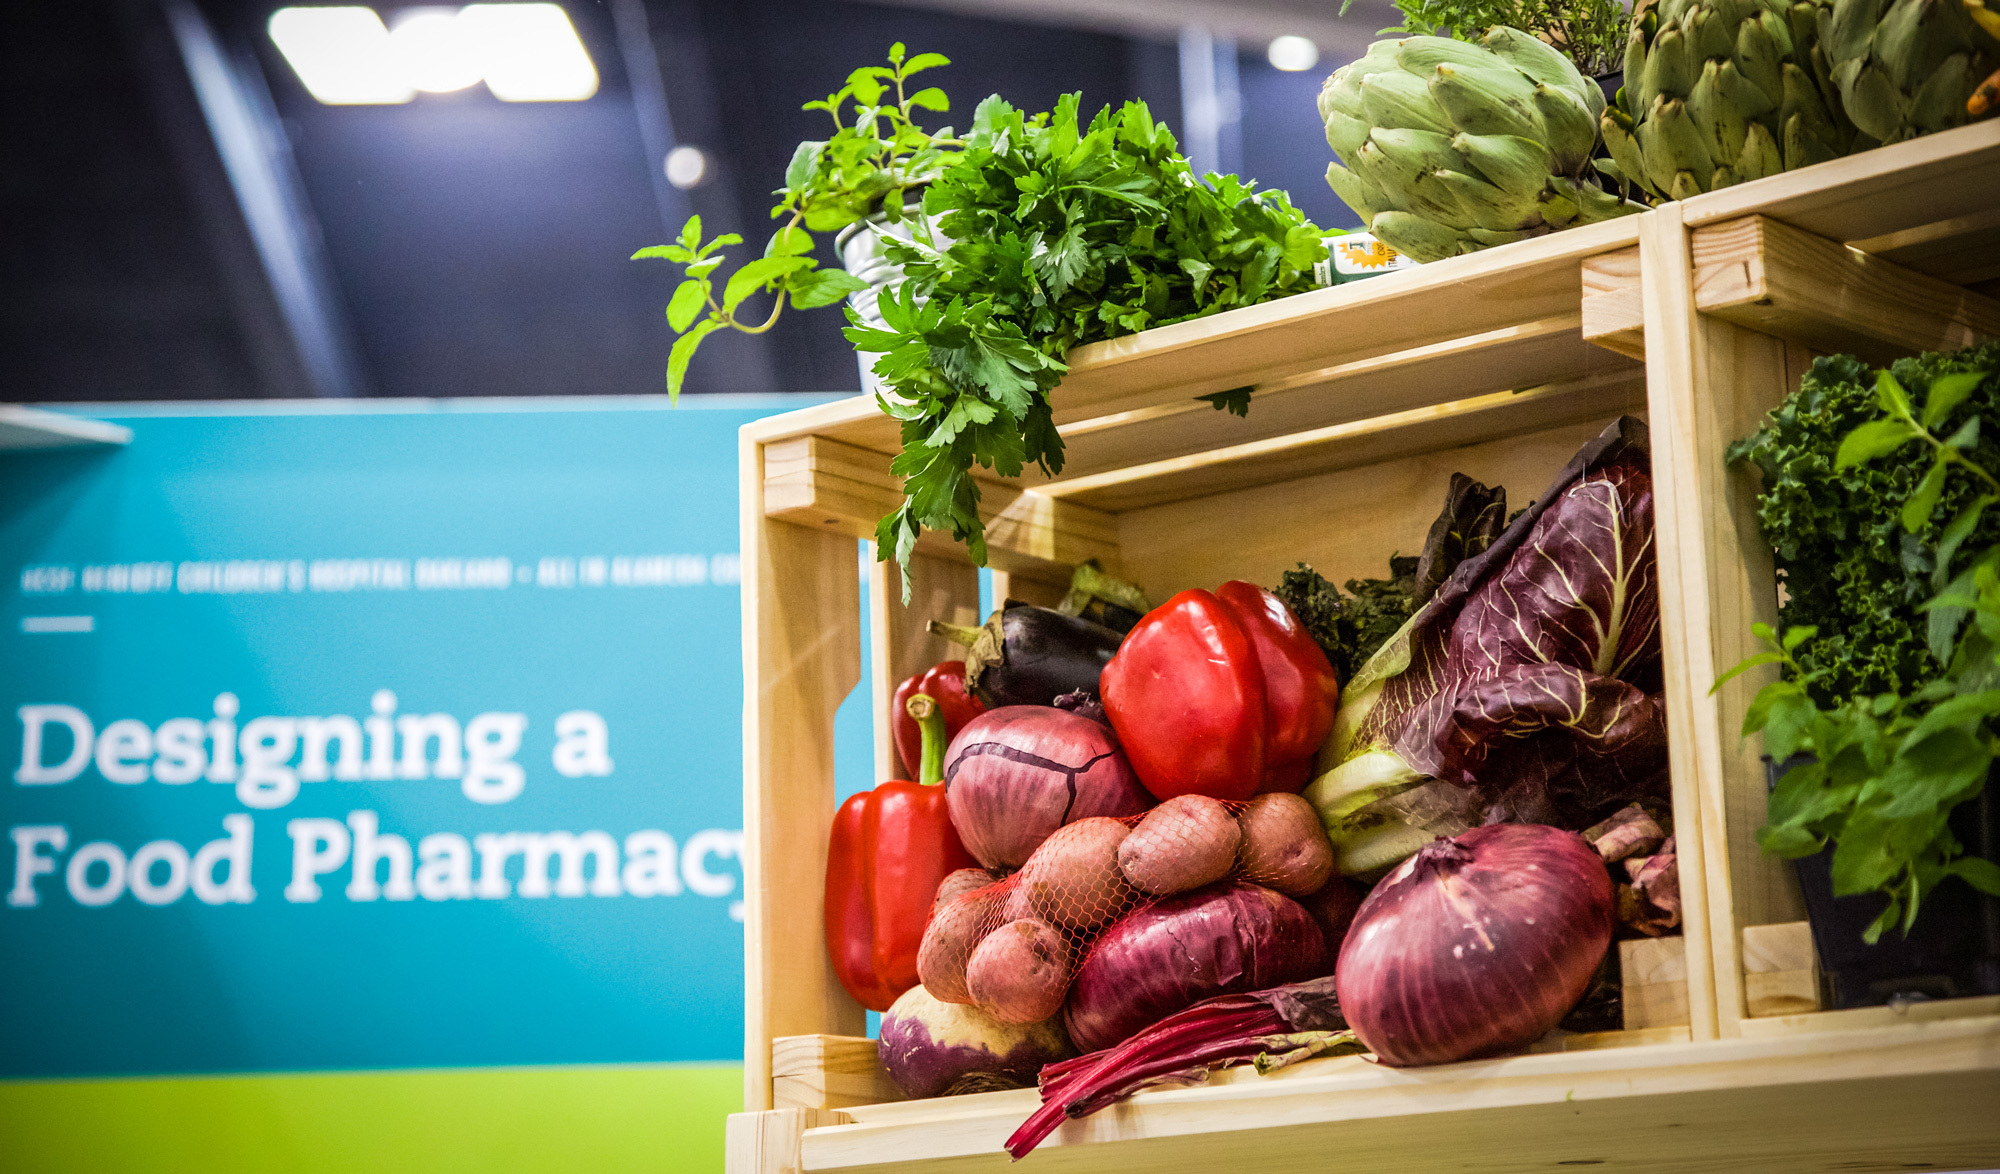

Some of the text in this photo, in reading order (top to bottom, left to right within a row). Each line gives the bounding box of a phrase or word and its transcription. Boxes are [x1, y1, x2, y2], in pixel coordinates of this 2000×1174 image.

[14, 692, 615, 809] Designing a
[10, 810, 744, 922] Food Pharmac
